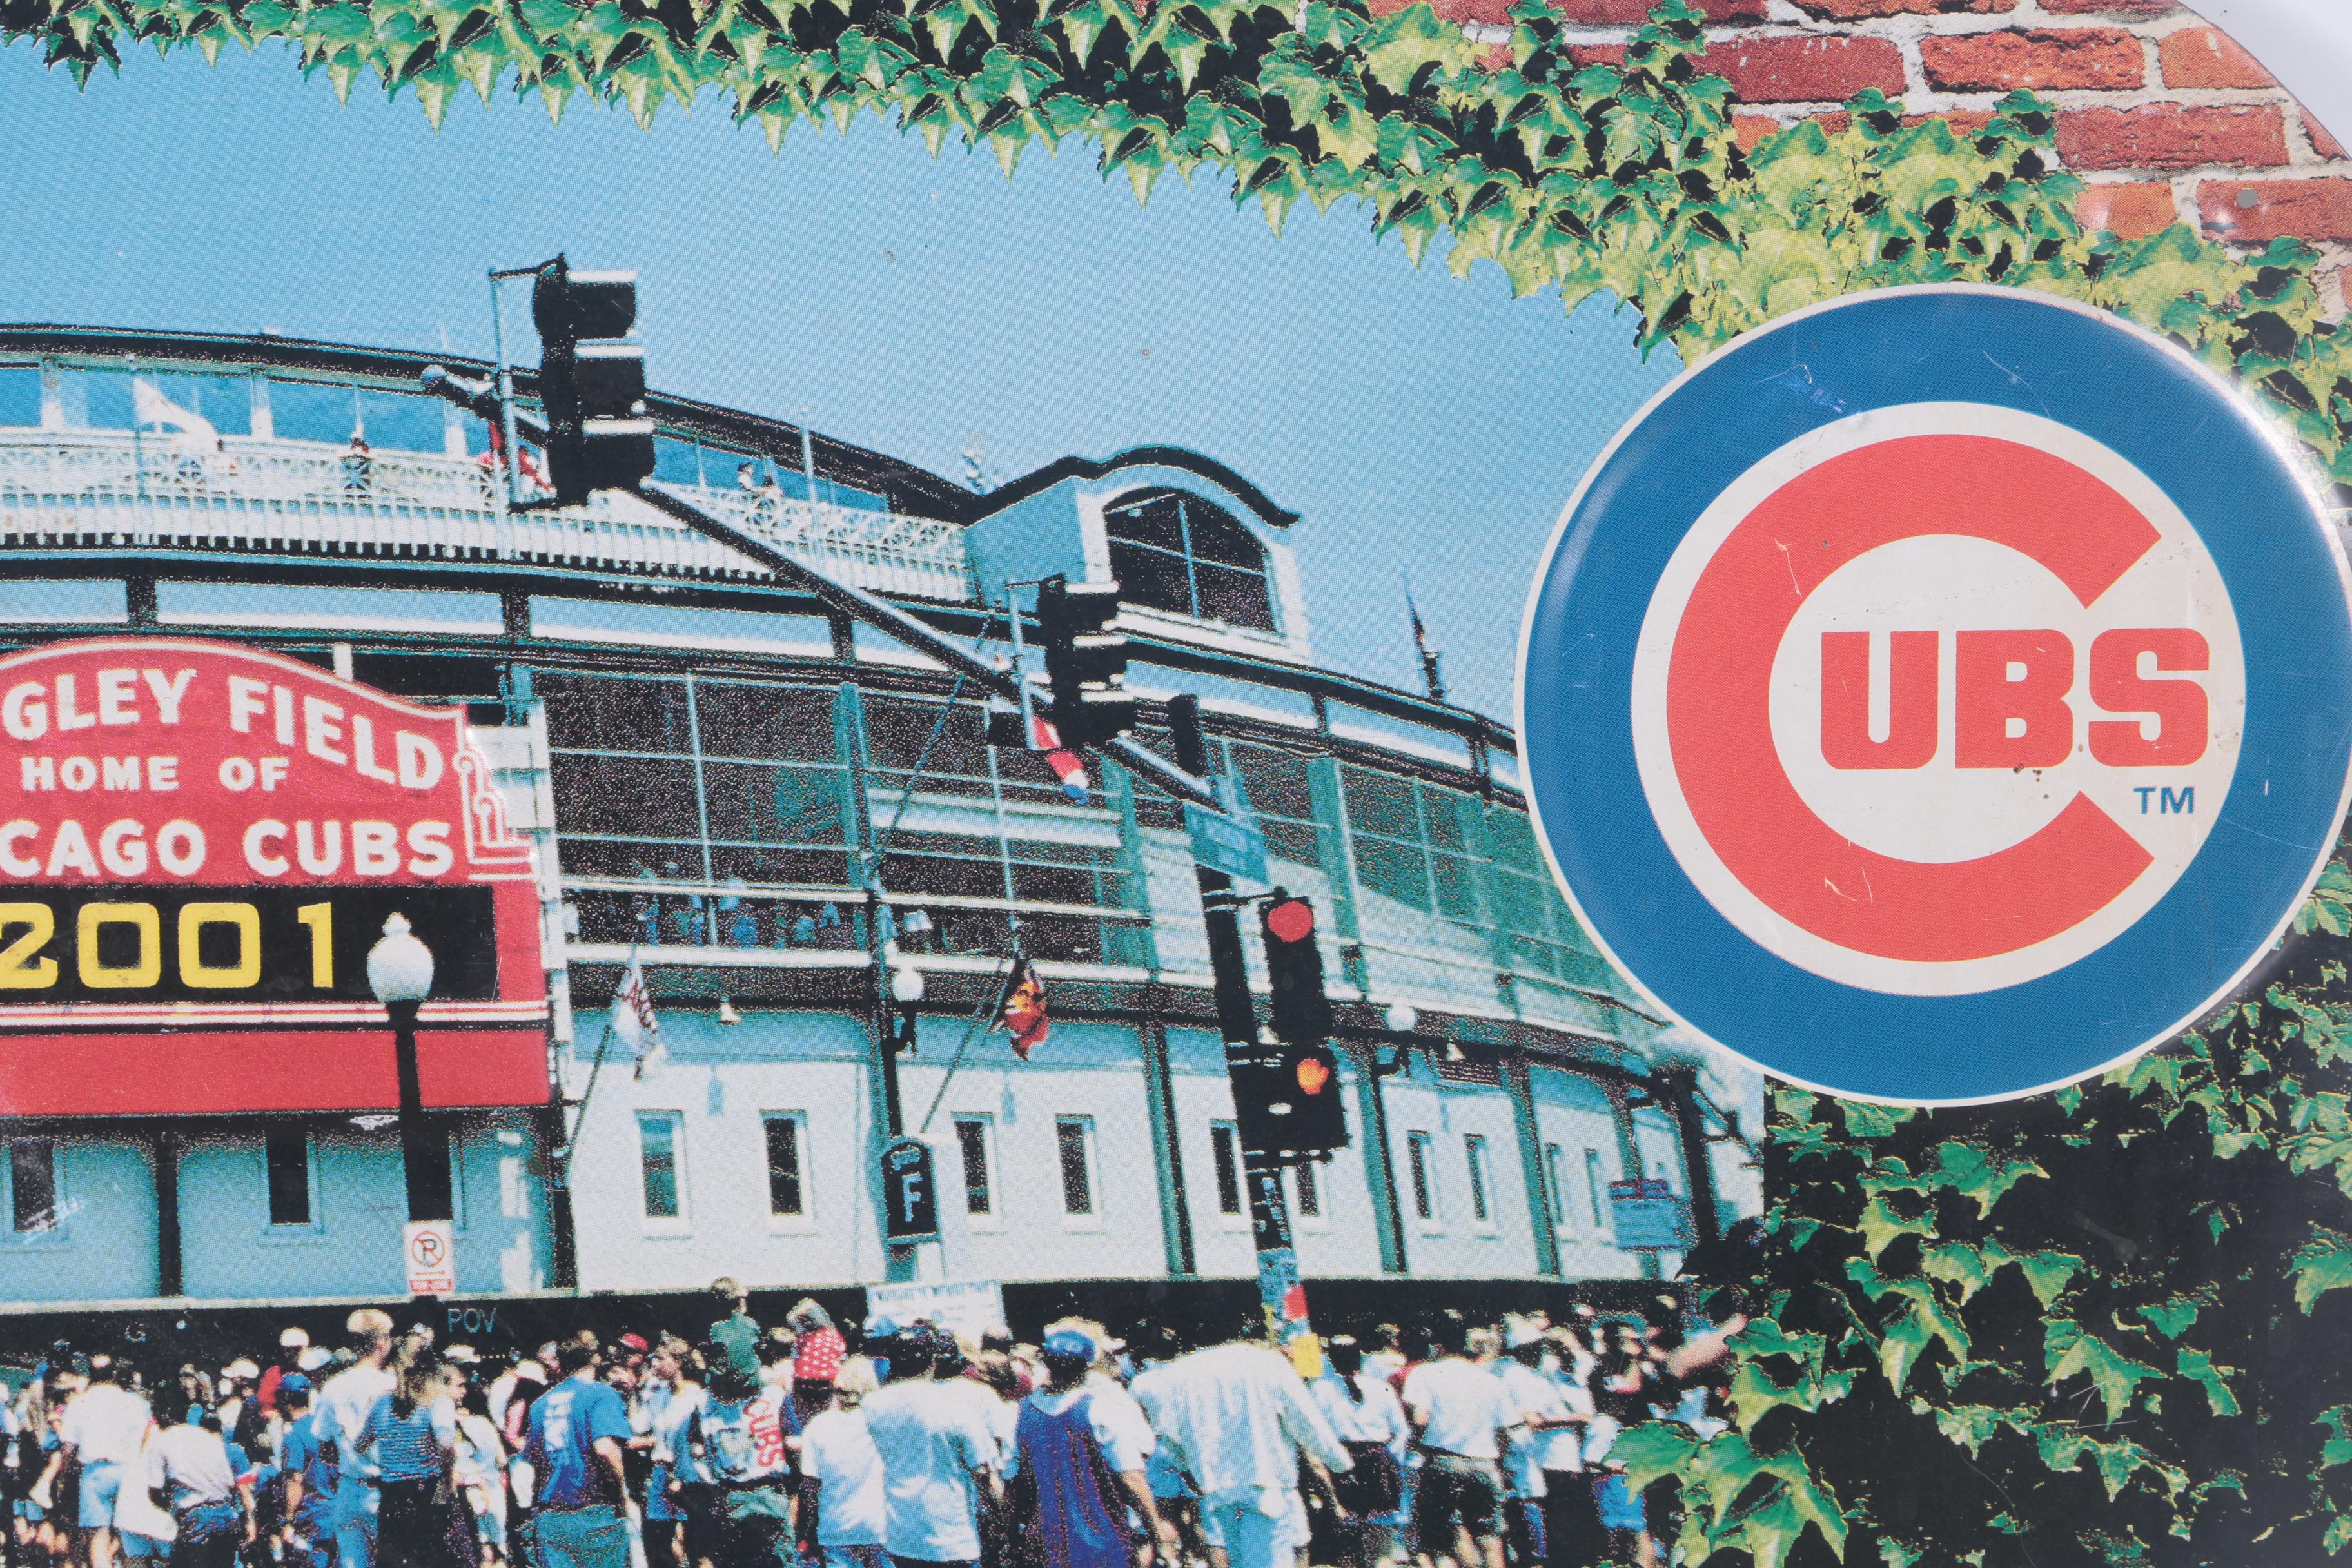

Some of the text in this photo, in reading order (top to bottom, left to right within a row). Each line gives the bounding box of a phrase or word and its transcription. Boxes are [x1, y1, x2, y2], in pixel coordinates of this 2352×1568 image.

[3, 668, 444, 790] GLEY FIELD
[21, 756, 289, 792] HOME OF
[2133, 786, 2195, 814] TM
[0, 819, 454, 877] CAGO CUBS
[0, 902, 333, 989] 2001
[901, 1172, 923, 1222] F
[447, 1308, 497, 1333] POV
[743, 1398, 787, 1467] CUBS
